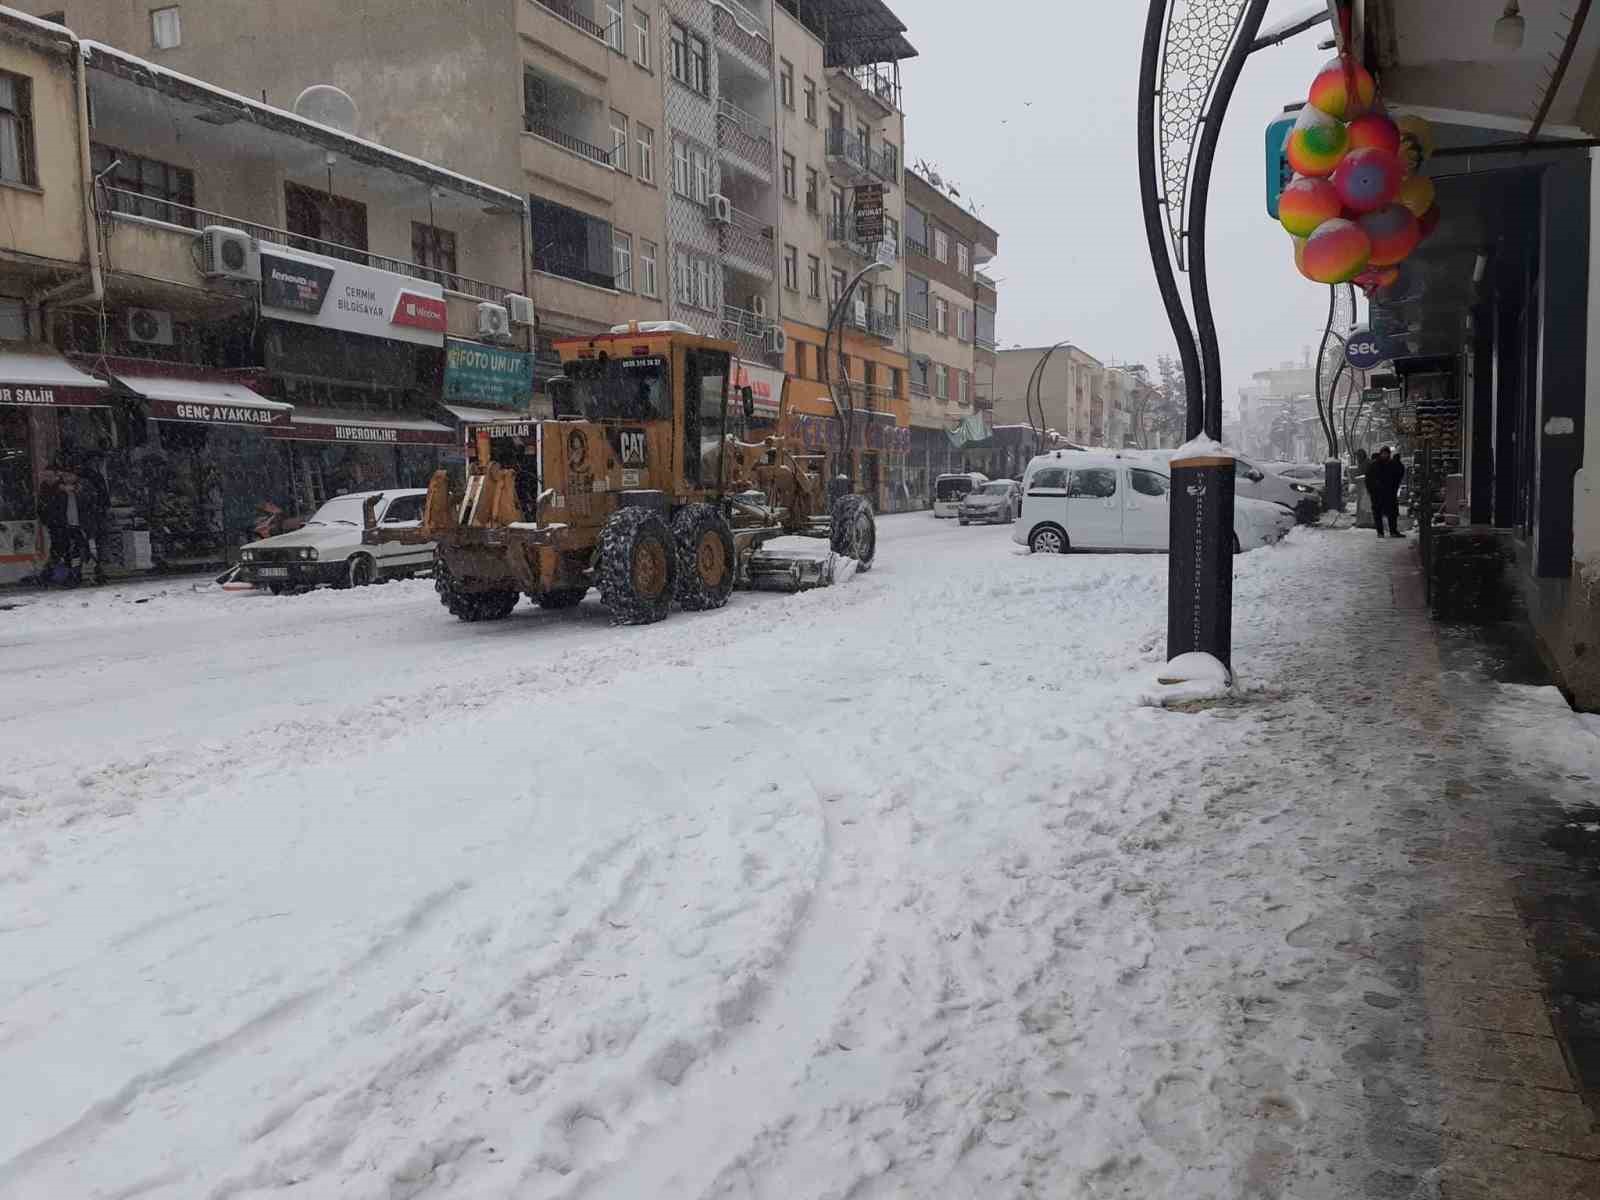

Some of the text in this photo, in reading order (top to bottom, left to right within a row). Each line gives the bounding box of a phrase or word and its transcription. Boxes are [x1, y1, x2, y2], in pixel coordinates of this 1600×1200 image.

[271, 268, 306, 287] lenovo
[490, 353, 521, 374] UMUT
[15, 386, 55, 403] SALİH
[176, 404, 272, 423] GENÇ AYAKKABI
[620, 431, 646, 464] CAT
